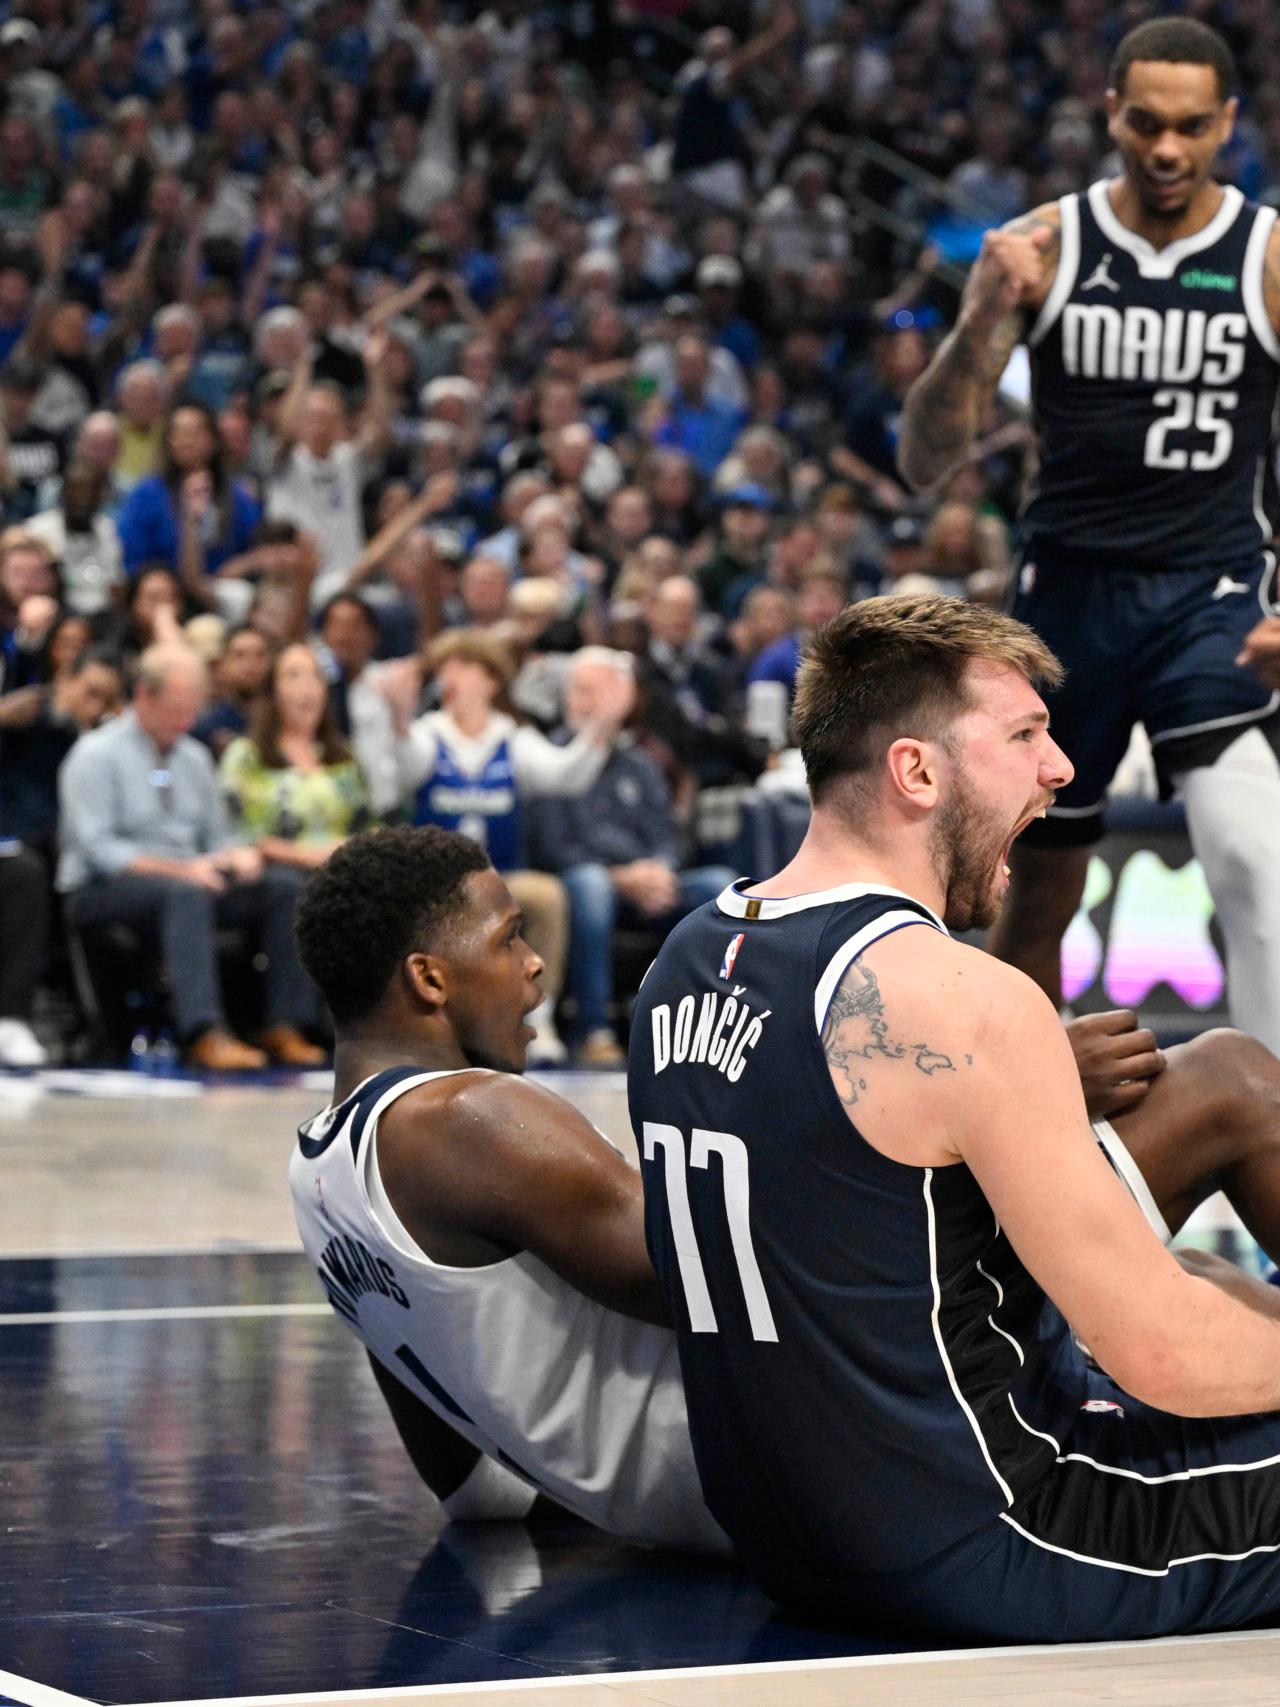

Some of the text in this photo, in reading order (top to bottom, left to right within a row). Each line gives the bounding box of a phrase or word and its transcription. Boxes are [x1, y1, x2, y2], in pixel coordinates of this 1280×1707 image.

[1062, 303, 1248, 385] MAVS
[1143, 389, 1239, 471] 25
[651, 984, 773, 1083] DONČIĆ
[642, 1121, 779, 1343] 77
